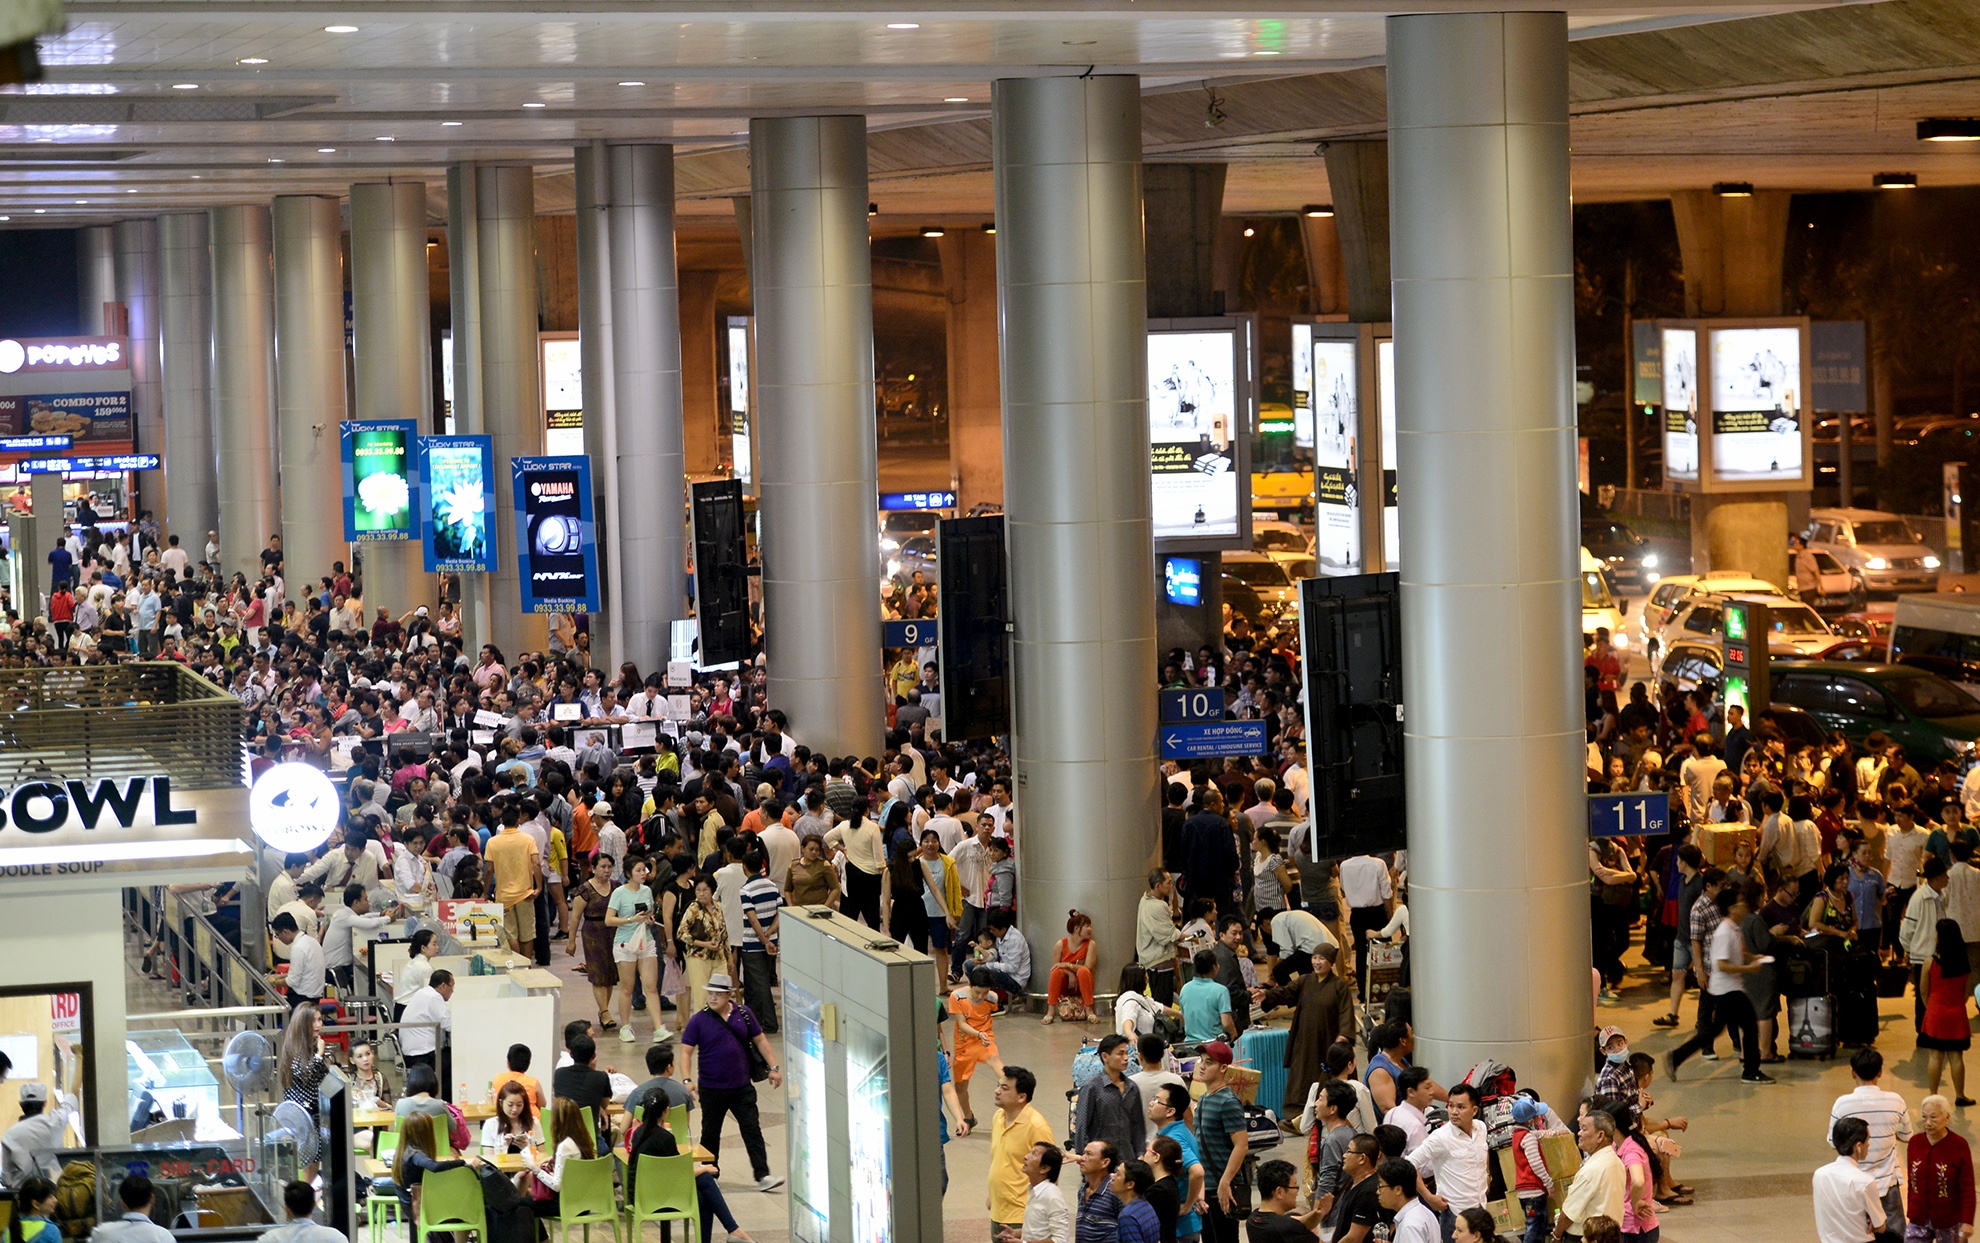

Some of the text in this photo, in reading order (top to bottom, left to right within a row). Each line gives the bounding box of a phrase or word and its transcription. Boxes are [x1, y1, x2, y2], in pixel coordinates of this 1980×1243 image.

[53, 396, 126, 407] COMBO FOR 2
[523, 462, 546, 470] LUCKY
[541, 482, 574, 495] YAMAHA
[436, 563, 486, 572] 0933.33.99.88
[534, 603, 587, 612] 0933.33.99.88
[904, 624, 918, 644] 9
[1177, 693, 1220, 717] 10 GF
[1217, 743, 1243, 751] LIMOUSINE
[0, 775, 197, 834] OWL
[1612, 800, 1663, 831] 11 GF
[57, 860, 104, 874] SOUP
[52, 1020, 75, 1029] OFFICE
[160, 1161, 190, 1177] SIM
[207, 1158, 256, 1174] CARD
